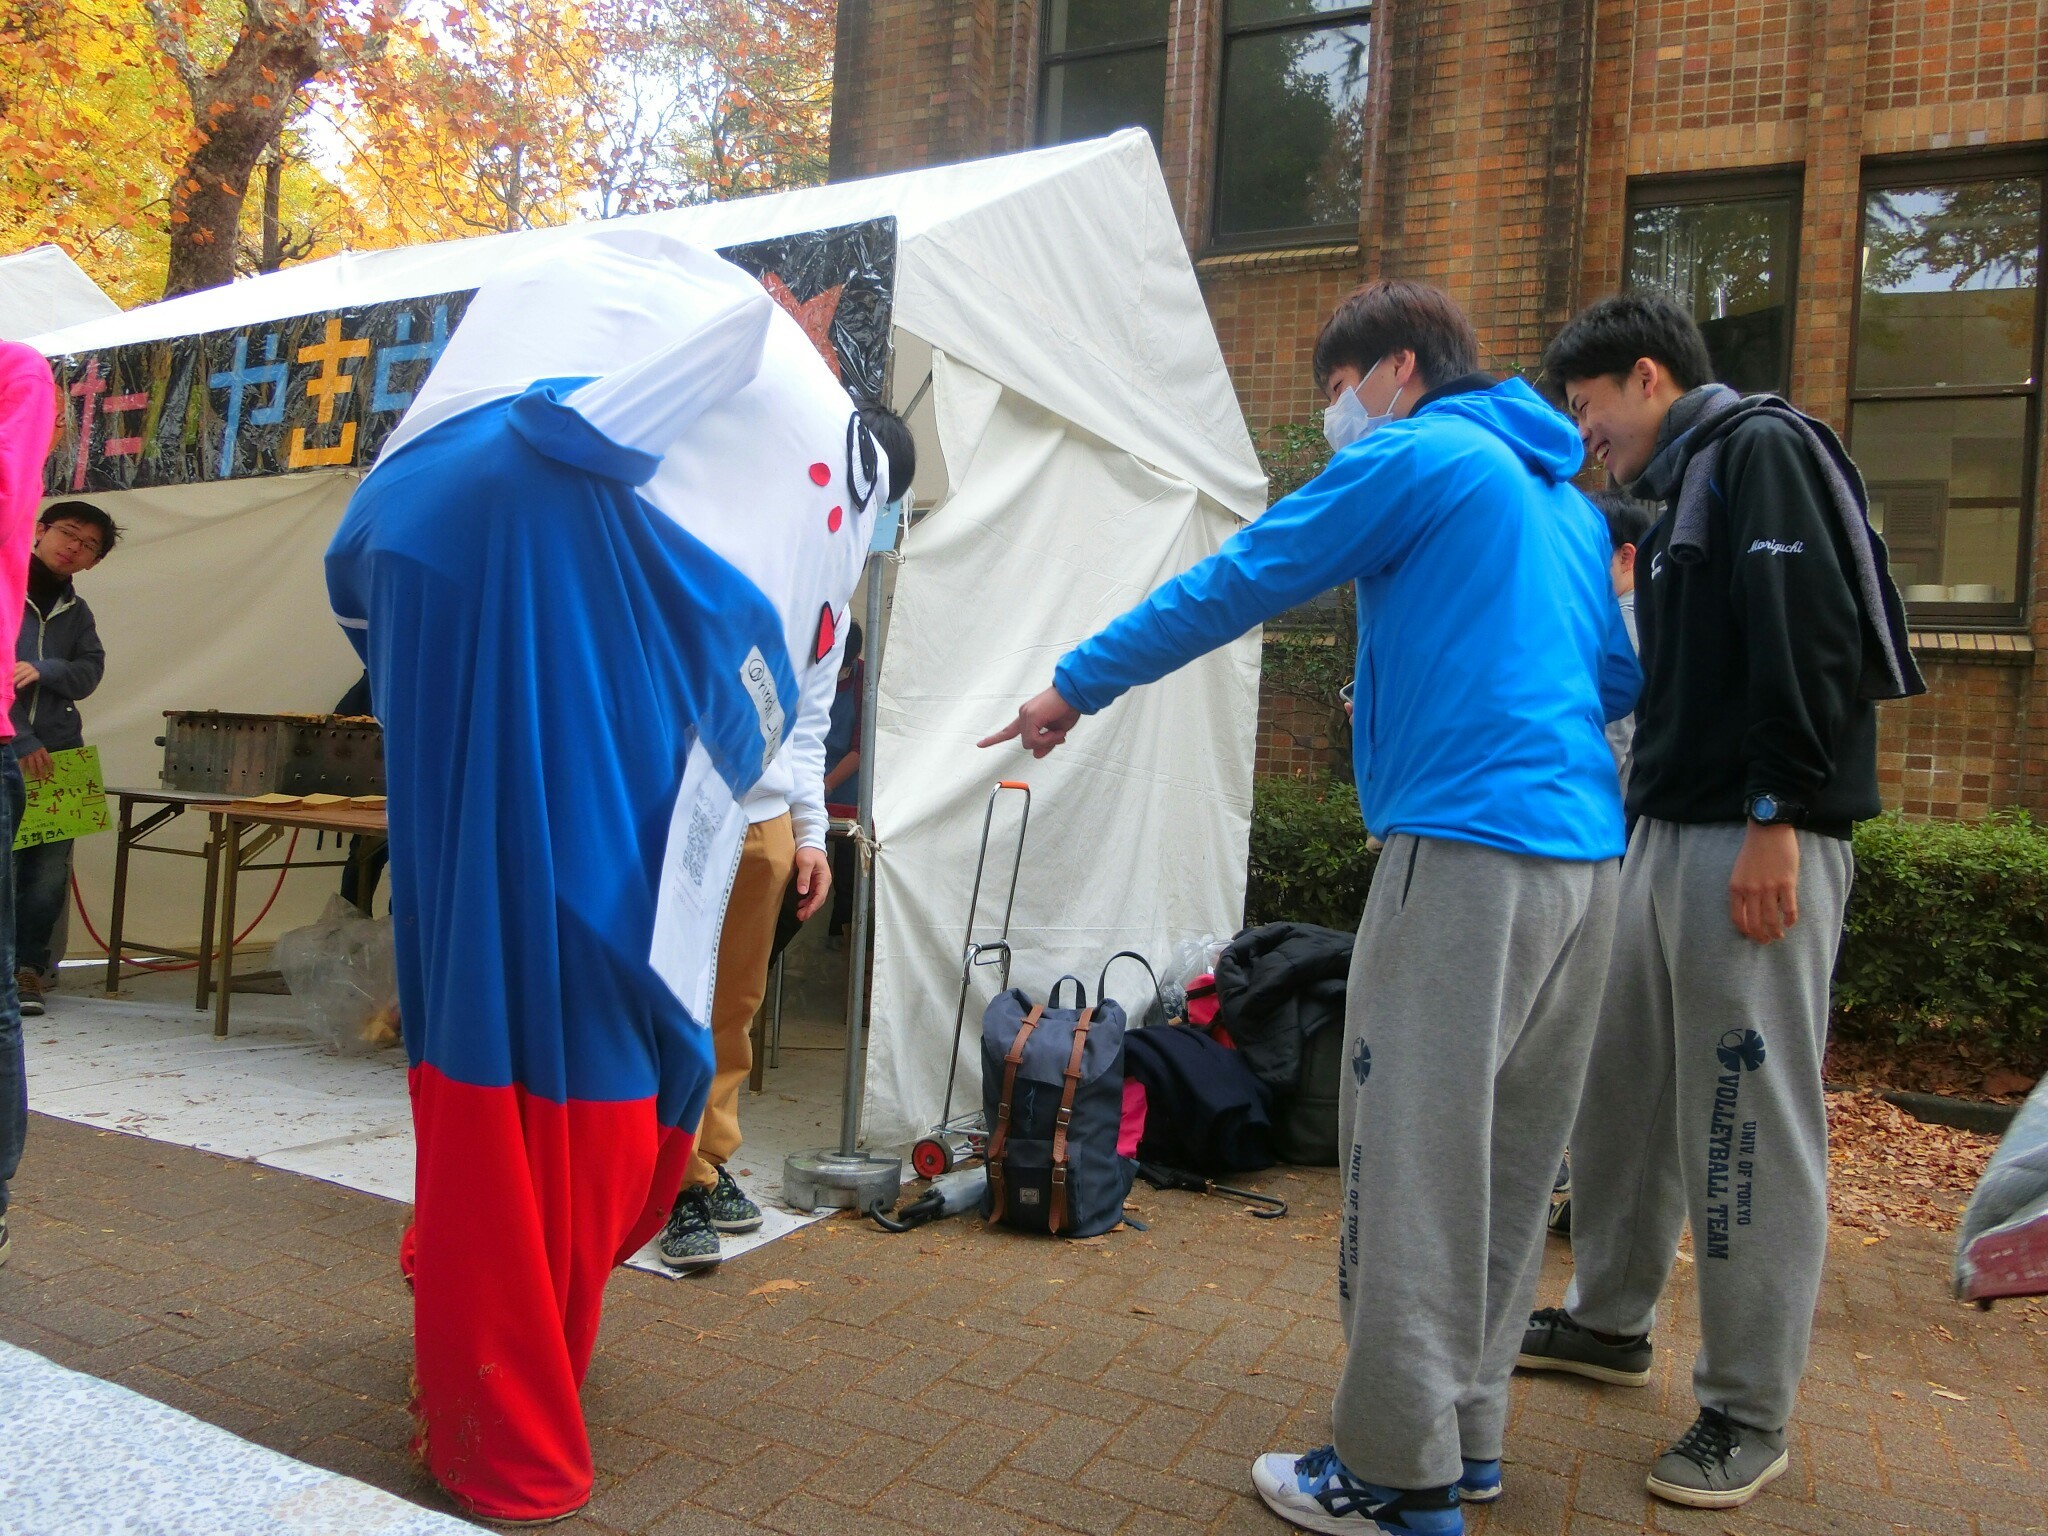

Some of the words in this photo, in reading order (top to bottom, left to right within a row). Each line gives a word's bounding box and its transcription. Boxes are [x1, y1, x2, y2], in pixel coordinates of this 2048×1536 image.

[1747, 538, 1804, 556] Moriguchi
[1707, 1073, 1740, 1198] VOLLEYBALL
[1739, 1120, 1757, 1156] UNIV.
[1738, 1160, 1754, 1177] OF
[1349, 1190, 1359, 1211] OF
[1737, 1181, 1752, 1226] TOKYO
[1348, 1215, 1359, 1266] TOKYO
[1707, 1204, 1729, 1260] TEAM
